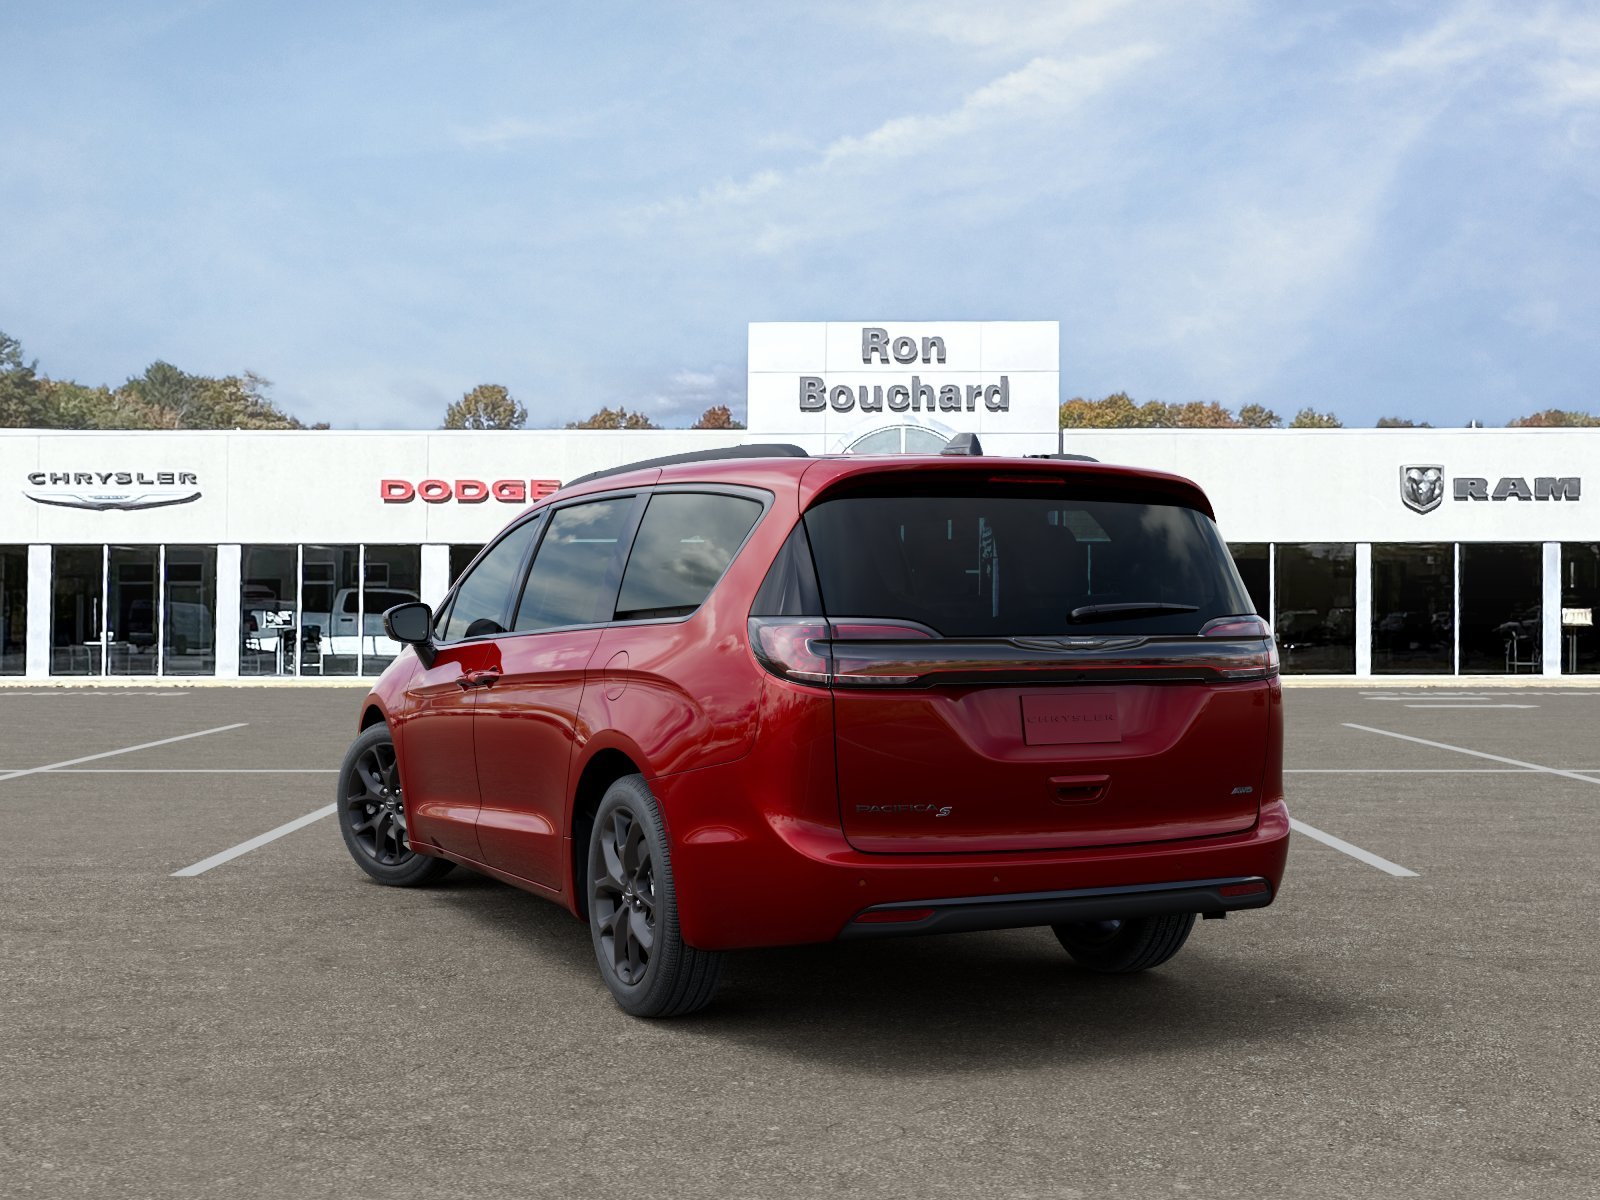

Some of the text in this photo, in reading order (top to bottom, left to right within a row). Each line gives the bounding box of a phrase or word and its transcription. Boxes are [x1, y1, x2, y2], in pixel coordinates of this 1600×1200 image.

[861, 327, 947, 364] Ron
[799, 375, 1010, 413] Bouchard
[27, 472, 198, 486] CHRYSLER
[380, 479, 562, 504] DODGE
[1452, 477, 1582, 502] RAM
[1025, 712, 1117, 724] CHRYSLER
[855, 803, 938, 814] PACIFICA
